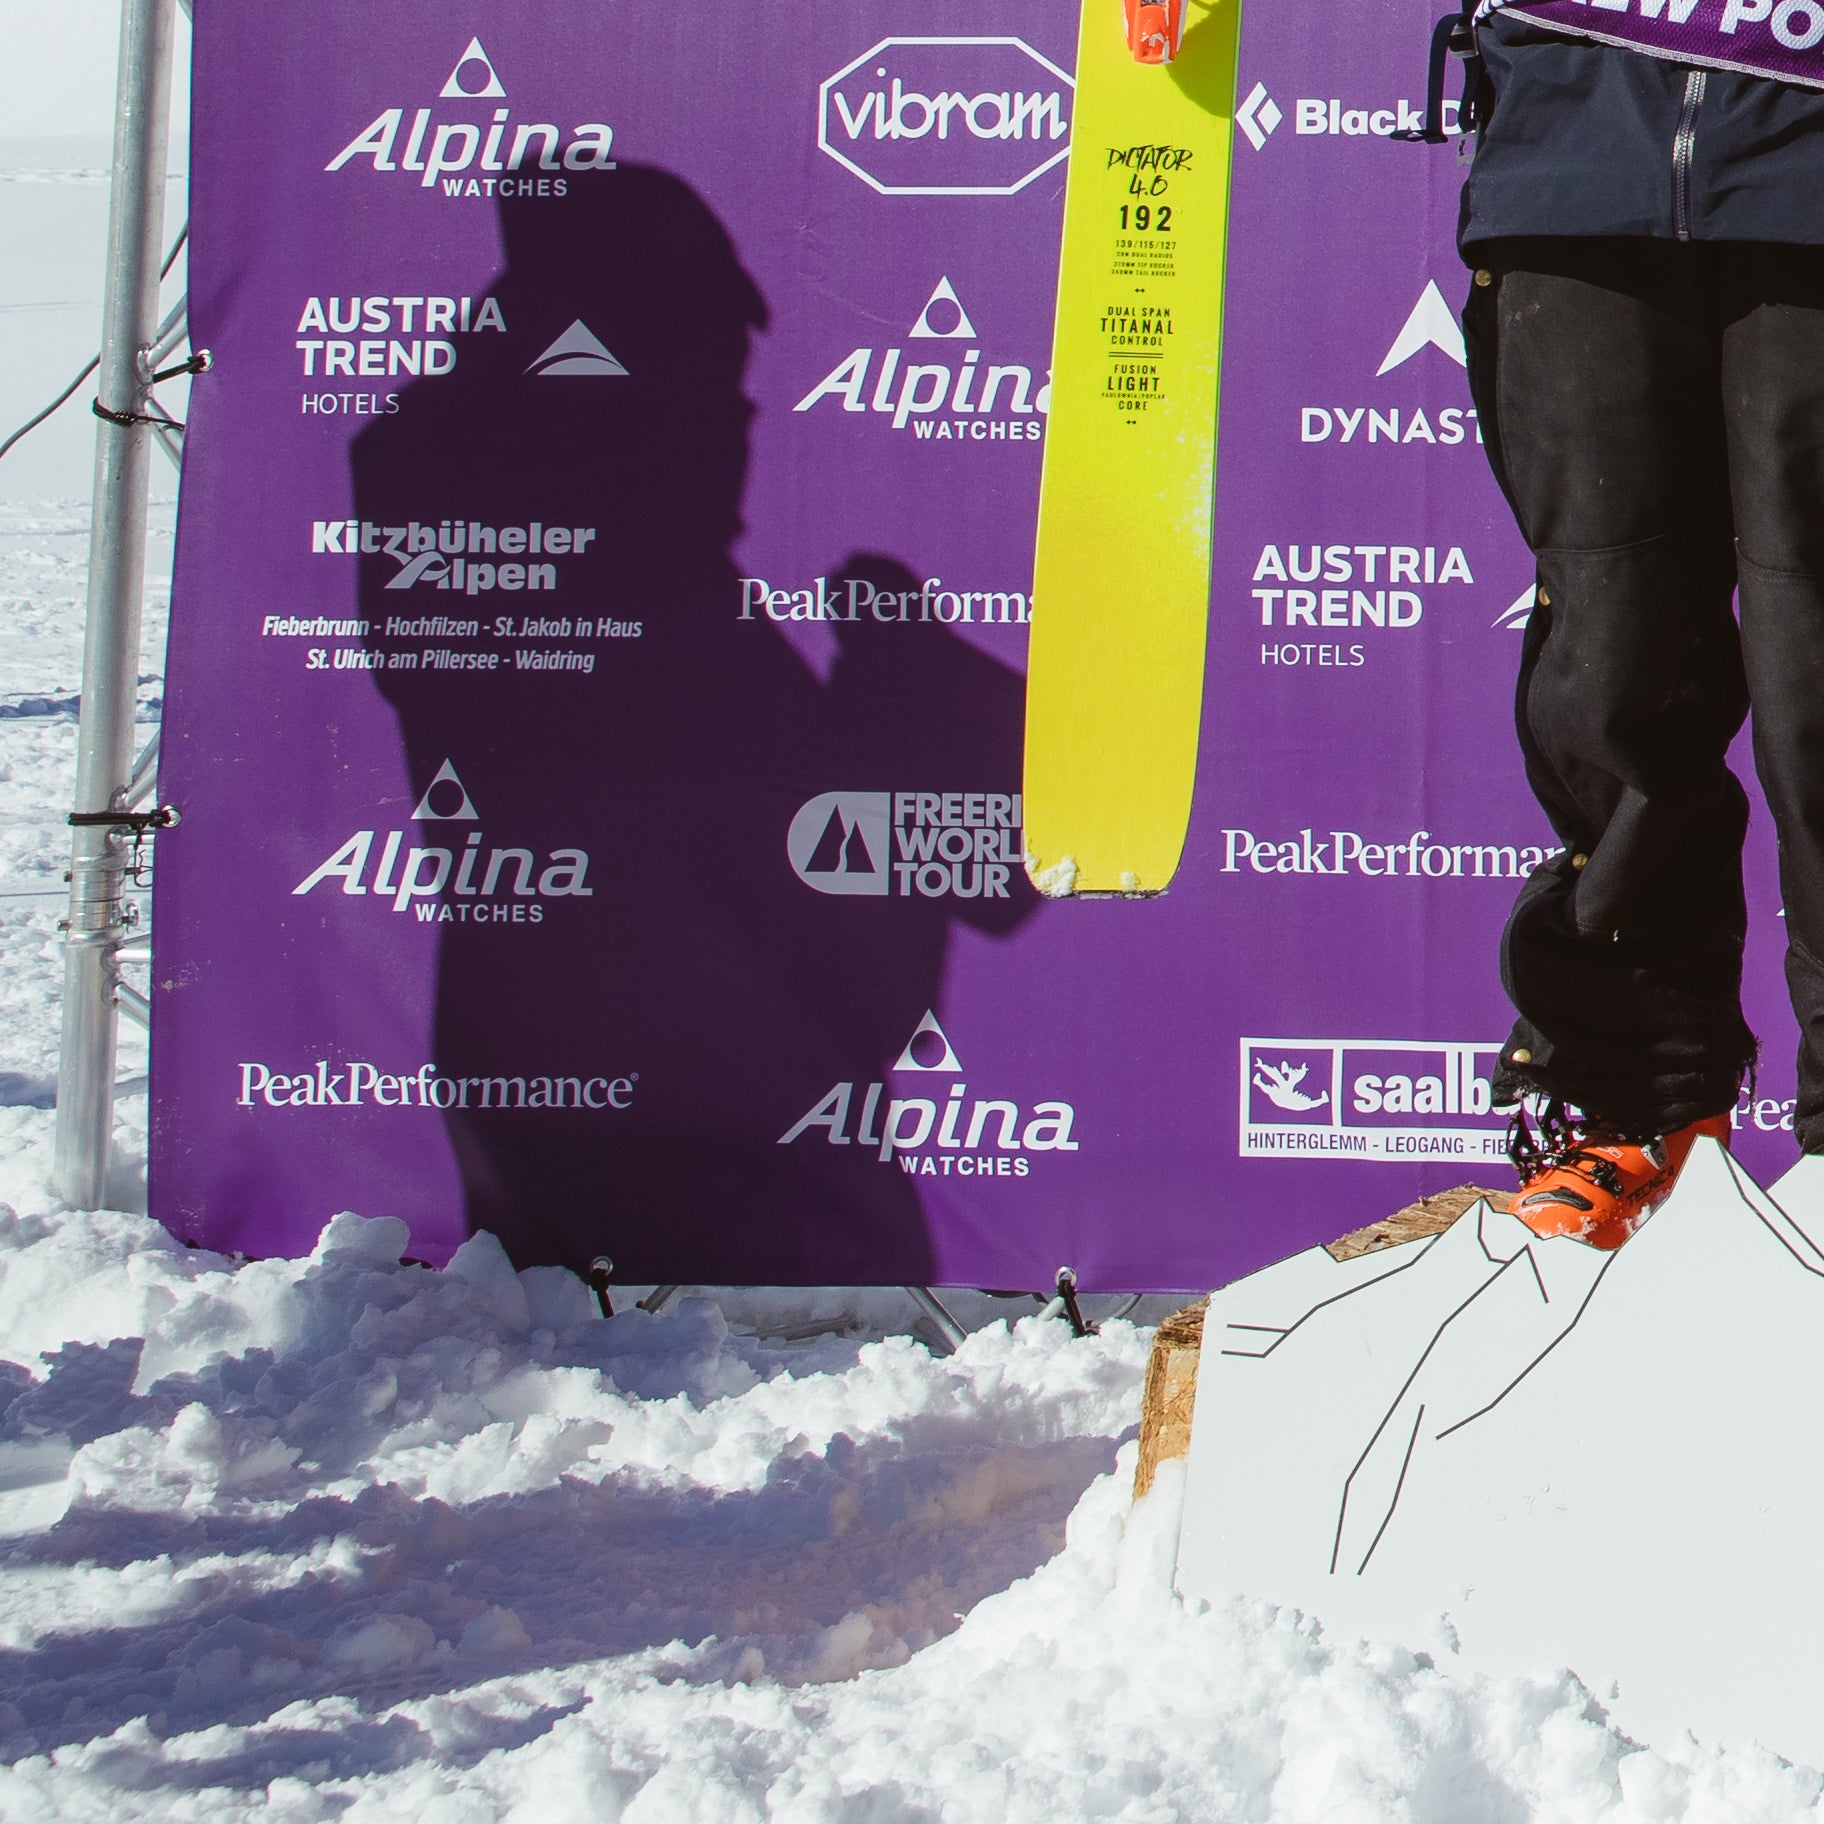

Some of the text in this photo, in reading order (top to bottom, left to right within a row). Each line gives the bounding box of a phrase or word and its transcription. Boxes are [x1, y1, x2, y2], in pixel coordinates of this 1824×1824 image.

[833, 67, 1068, 142] vibram
[324, 108, 617, 187] Alpina
[1105, 144, 1193, 172] DICTATOR
[442, 178, 568, 198] WATCHES
[1129, 175, 1169, 201] 4.0
[1120, 204, 1172, 232] 192
[297, 296, 507, 336] AUSTRIA
[1107, 306, 1171, 318] DUAL SPAN
[1100, 317, 1174, 335] TITANAL
[1111, 335, 1164, 347] CONTROL
[296, 341, 457, 375] TREND
[1113, 363, 1157, 375] FUSION
[1107, 376, 1161, 392] LIGHT
[302, 392, 400, 415] HOTELS
[1118, 400, 1148, 411] CORE
[914, 421, 1040, 440] WATCHES
[311, 520, 596, 565] Kitzbüheler
[384, 548, 557, 596] Alpen
[1253, 545, 1473, 583] AUSTRIA
[1252, 589, 1422, 627] TREND
[1262, 644, 1364, 666] HOTELS
[291, 831, 594, 912] Alpina
[416, 903, 544, 924] WATCHES
[777, 1081, 1080, 1164] Alpina
[898, 1156, 1030, 1176] WATCHES
